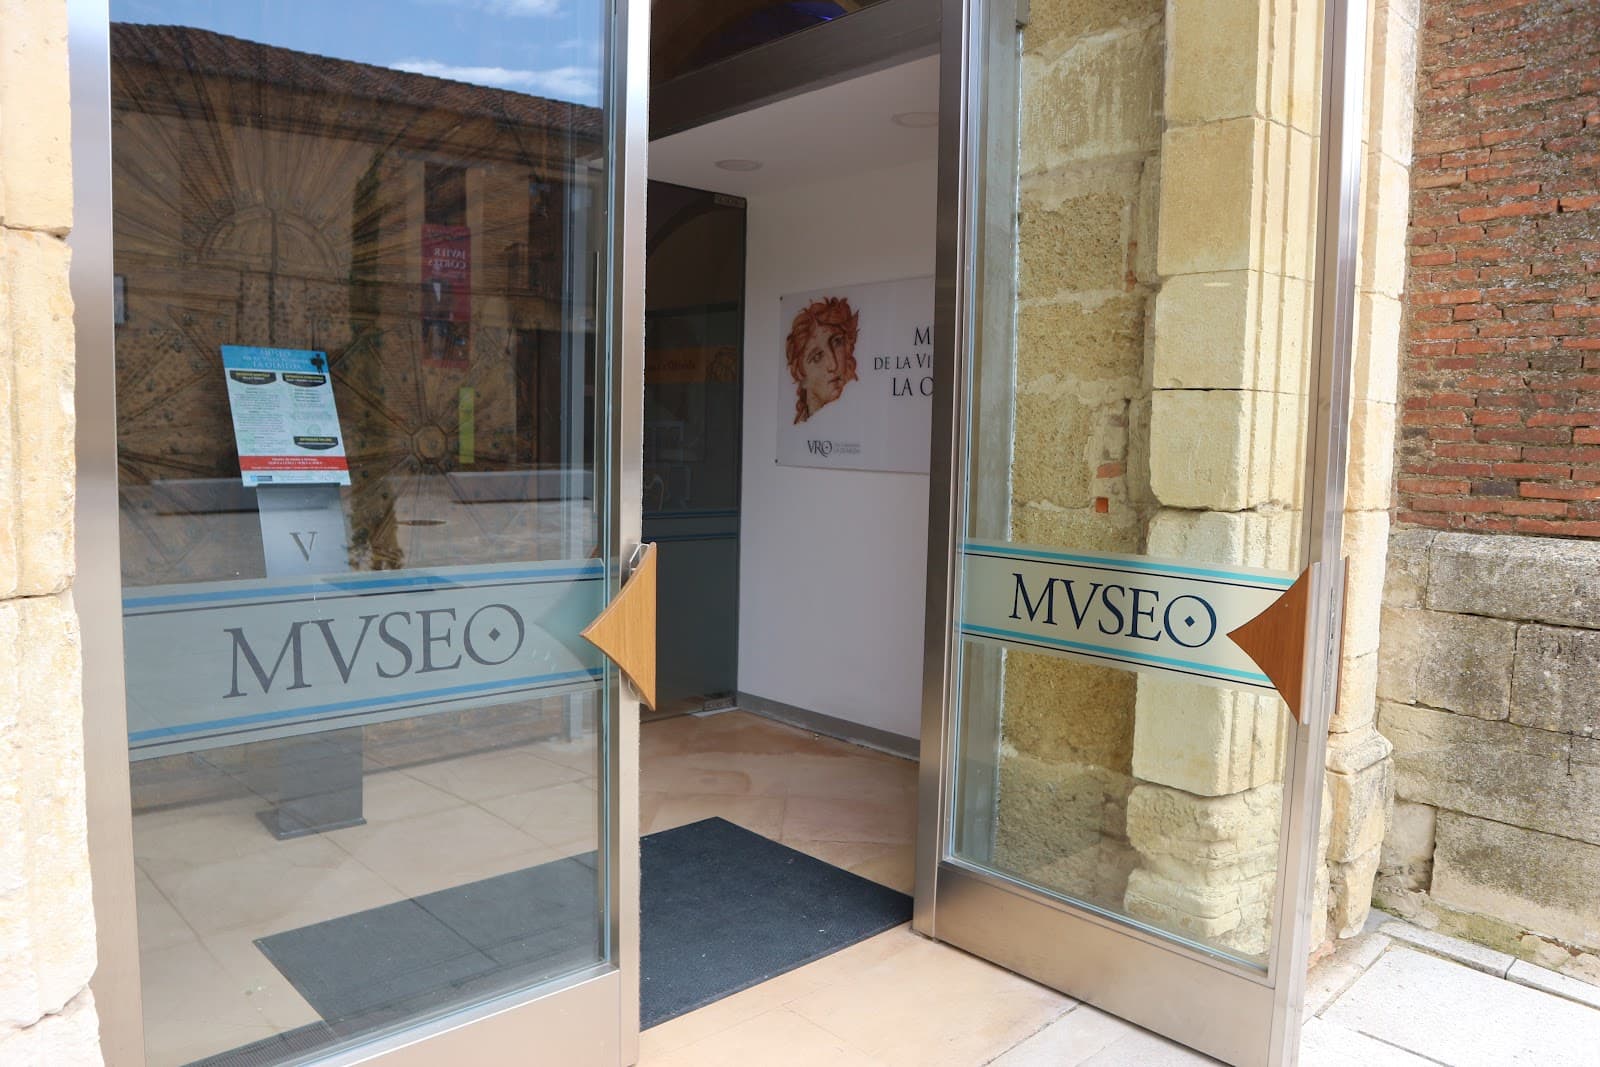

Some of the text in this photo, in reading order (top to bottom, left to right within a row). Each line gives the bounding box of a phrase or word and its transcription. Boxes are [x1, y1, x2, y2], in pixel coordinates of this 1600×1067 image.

[913, 326, 931, 346] M
[874, 353, 931, 370] DE LA VI
[892, 377, 913, 396] LA
[290, 531, 317, 561] V
[1009, 572, 1217, 648] MVSEO
[222, 603, 525, 699] MVSEO
